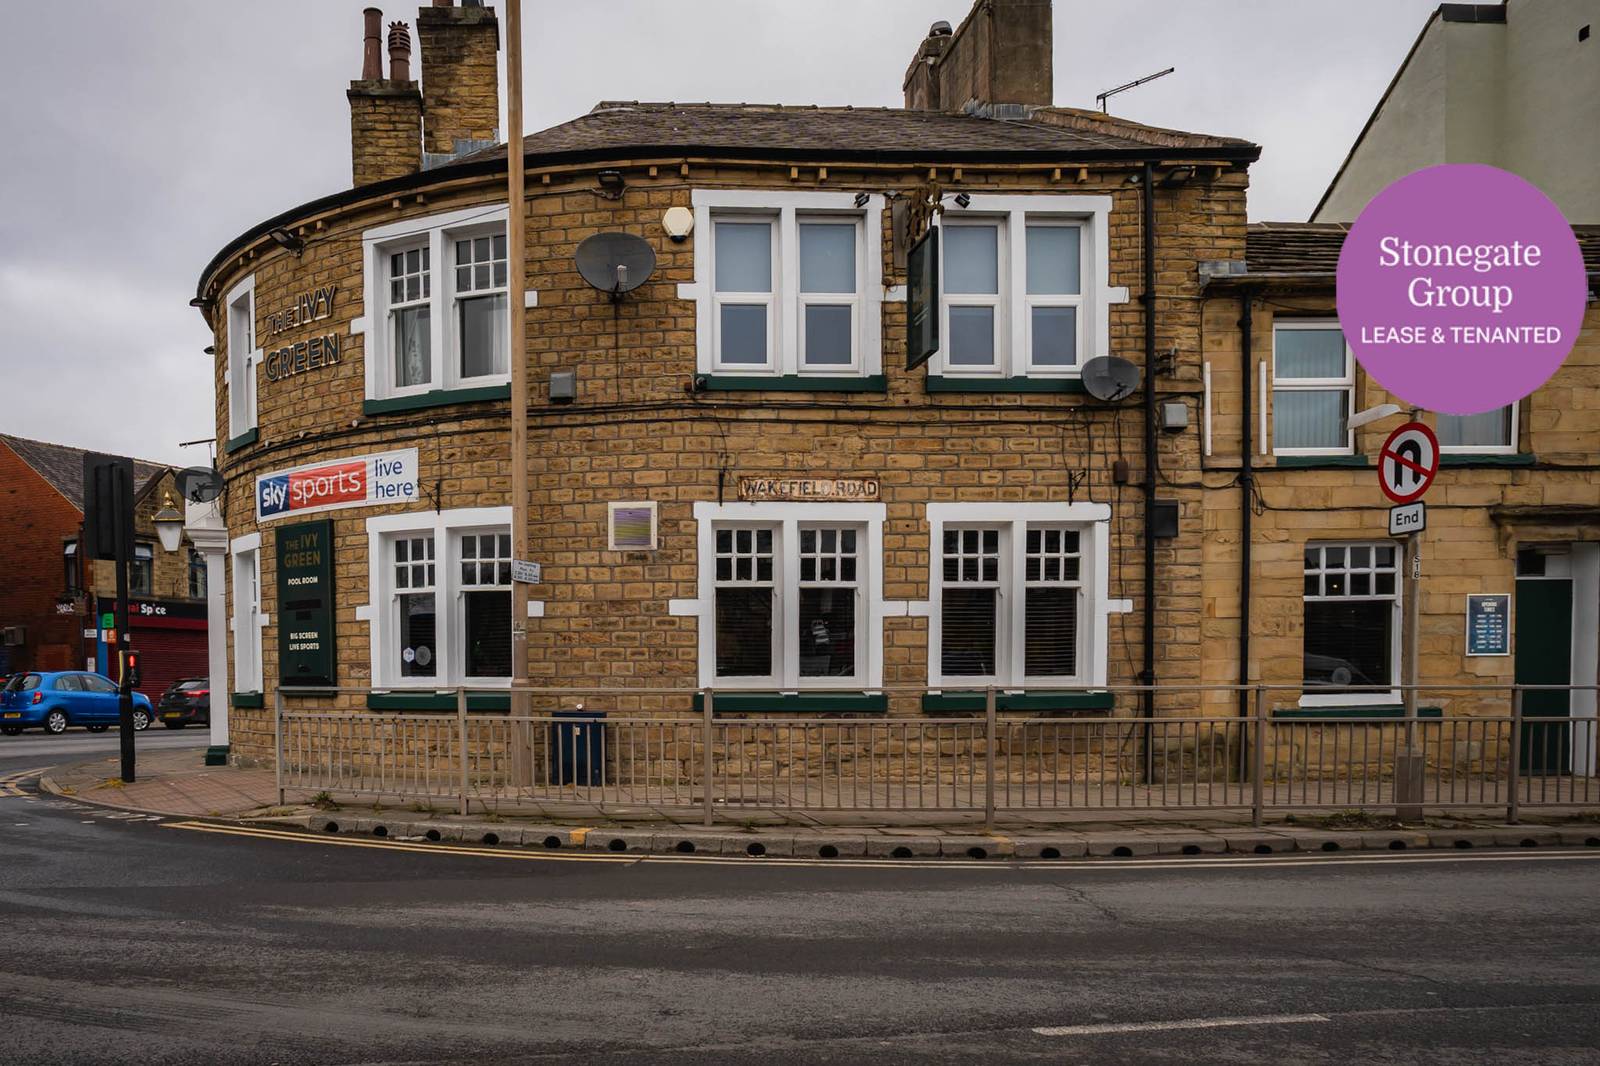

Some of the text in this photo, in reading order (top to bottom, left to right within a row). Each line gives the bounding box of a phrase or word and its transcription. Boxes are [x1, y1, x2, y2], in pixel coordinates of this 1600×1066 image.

[267, 285, 335, 334] THE IVY
[265, 332, 340, 382] GREEN
[374, 458, 403, 477] live
[262, 470, 362, 510] sky sports
[374, 480, 413, 498] here
[743, 480, 877, 496] WAKEFIELD ROAD
[1395, 510, 1418, 526] End
[285, 534, 318, 552] THE IVY
[284, 552, 321, 567] GREEN
[287, 576, 318, 586] POOL ROOM
[290, 631, 318, 640] BIG SCREEN
[288, 642, 320, 651] LIVE SPORTS
